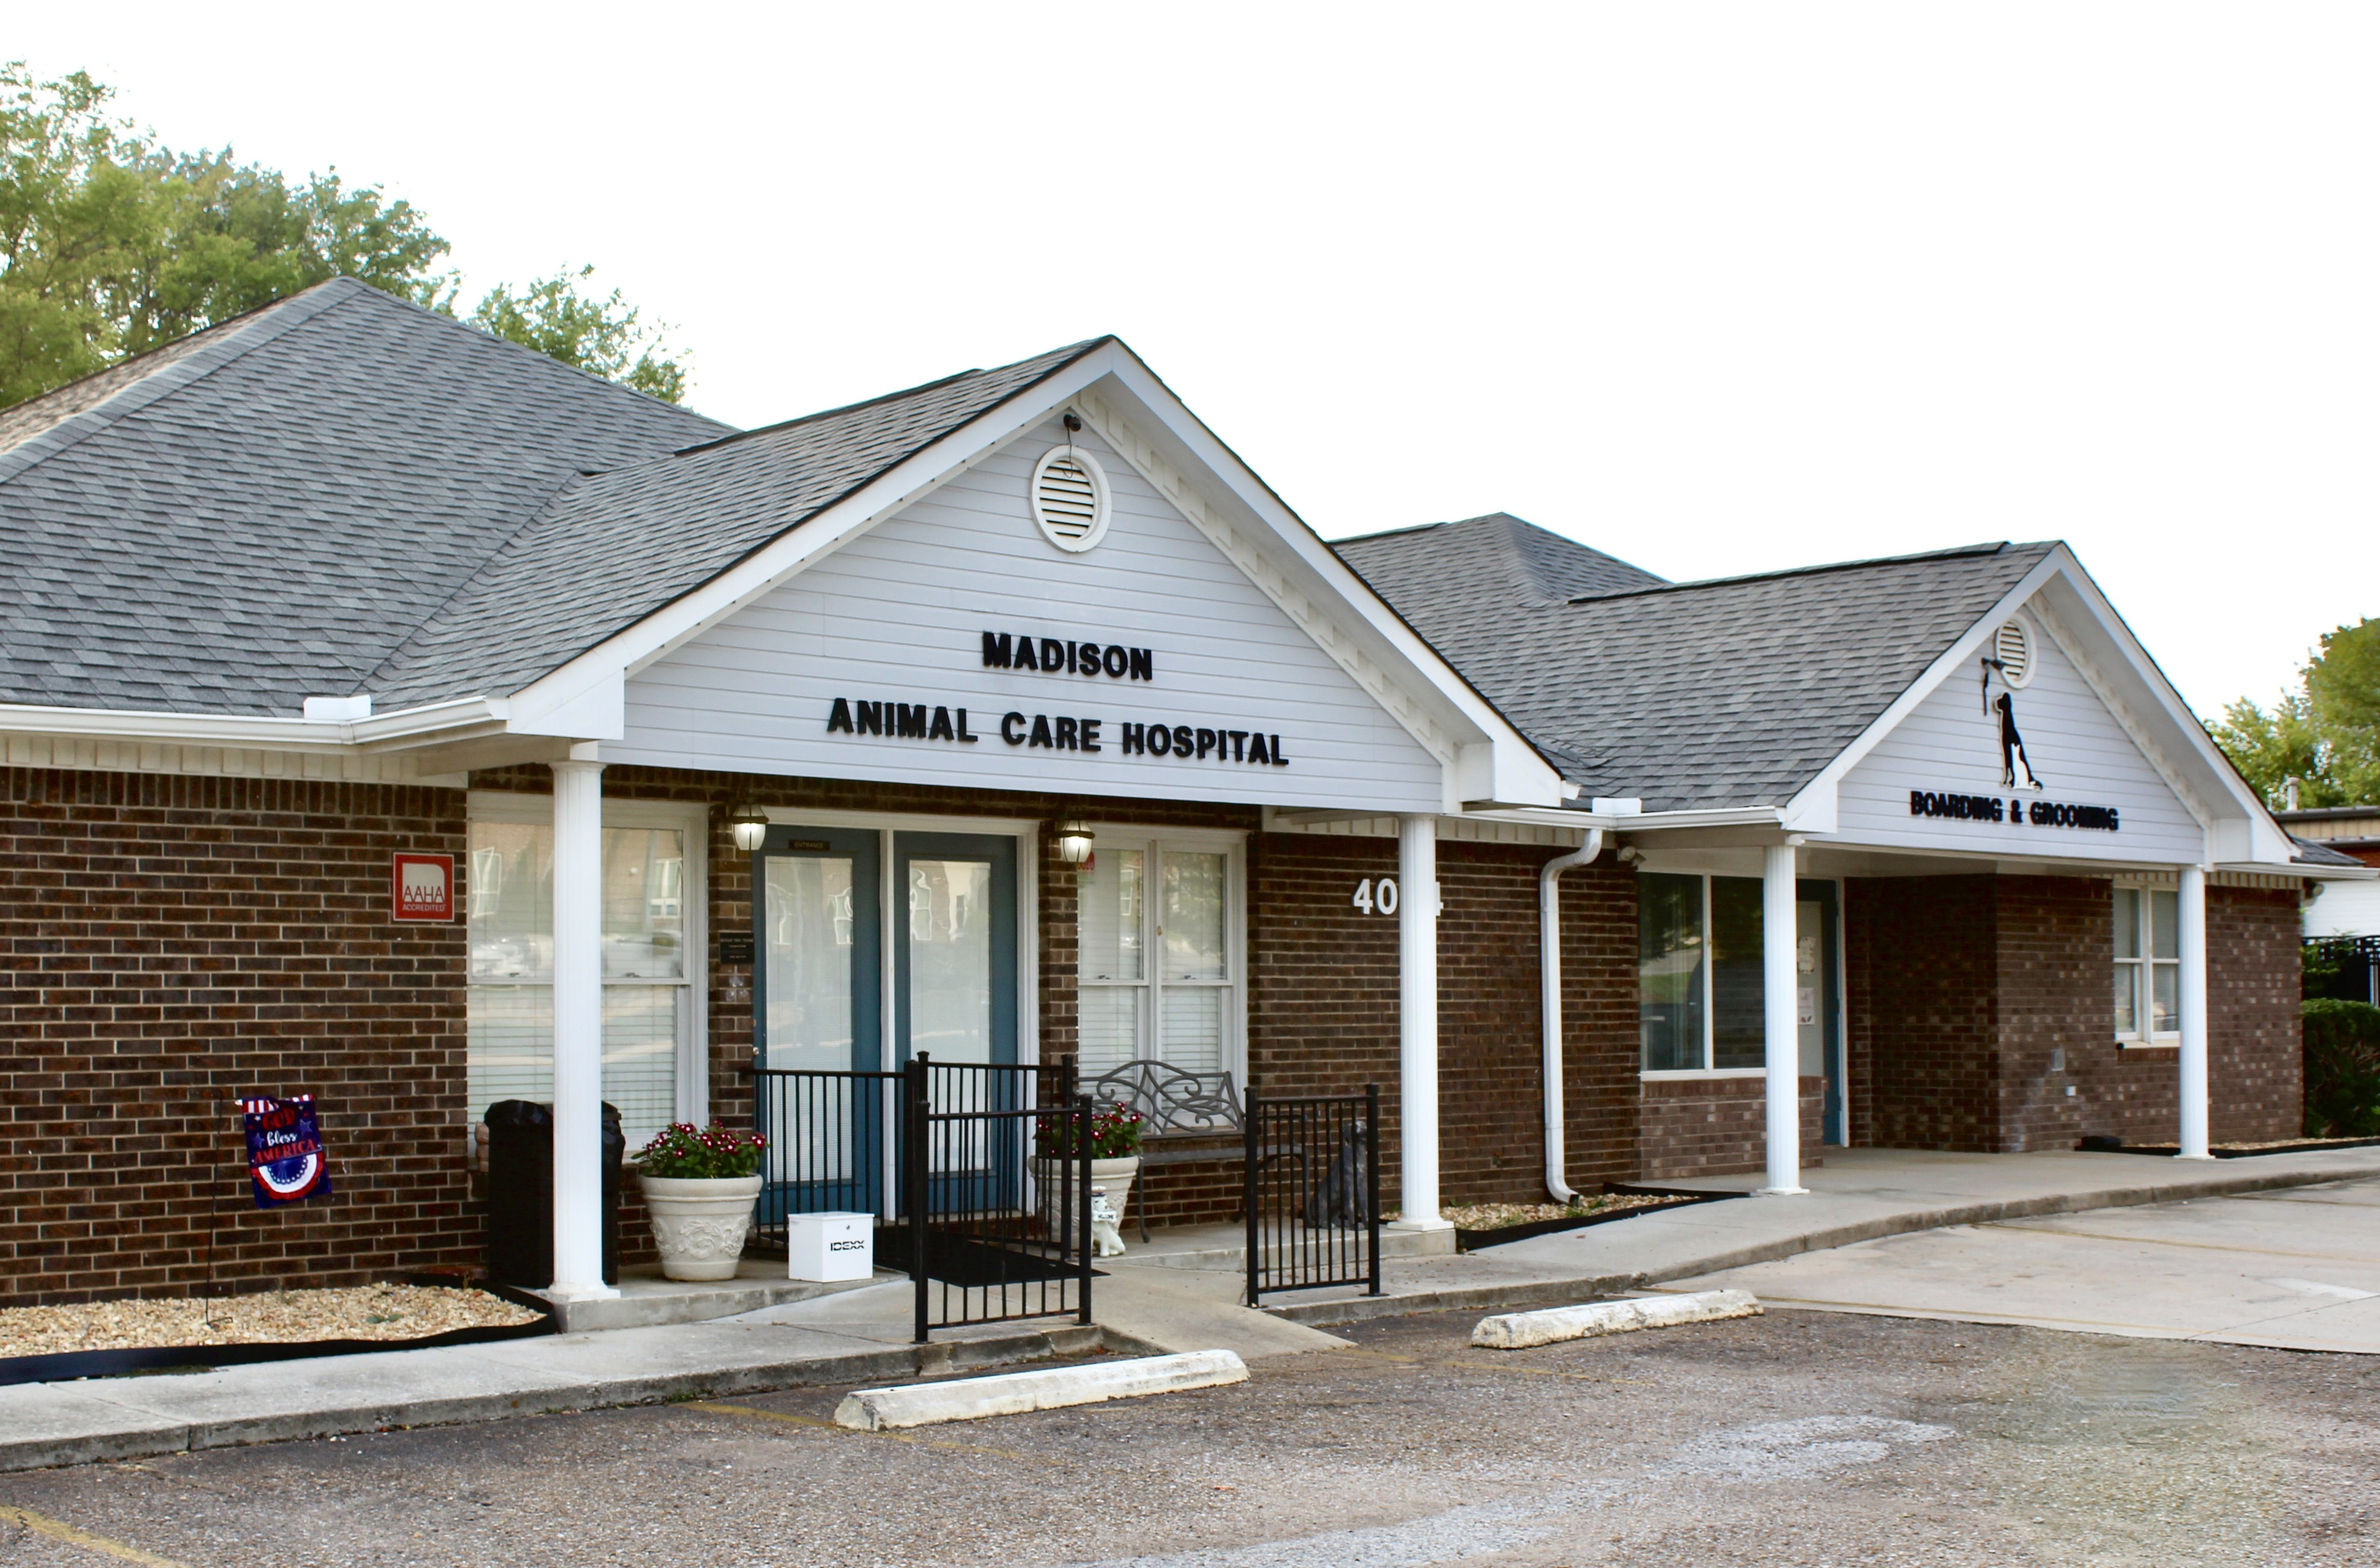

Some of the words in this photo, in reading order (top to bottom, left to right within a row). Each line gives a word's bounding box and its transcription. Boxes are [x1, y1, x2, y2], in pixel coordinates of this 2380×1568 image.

[982, 631, 1152, 681] MADISON
[827, 698, 978, 742] ANIMAL
[1001, 712, 1101, 752] CARE
[1122, 722, 1289, 766] HOSPITAL
[1910, 791, 2003, 821] BOARDING
[2010, 800, 2022, 823] &
[2029, 802, 2119, 831] GROOMING
[403, 885, 445, 903] AAHA
[262, 1108, 296, 1130] GOD
[267, 1130, 298, 1147] bless
[255, 1139, 316, 1164] AMERICA
[830, 1240, 865, 1251] IDEXX
